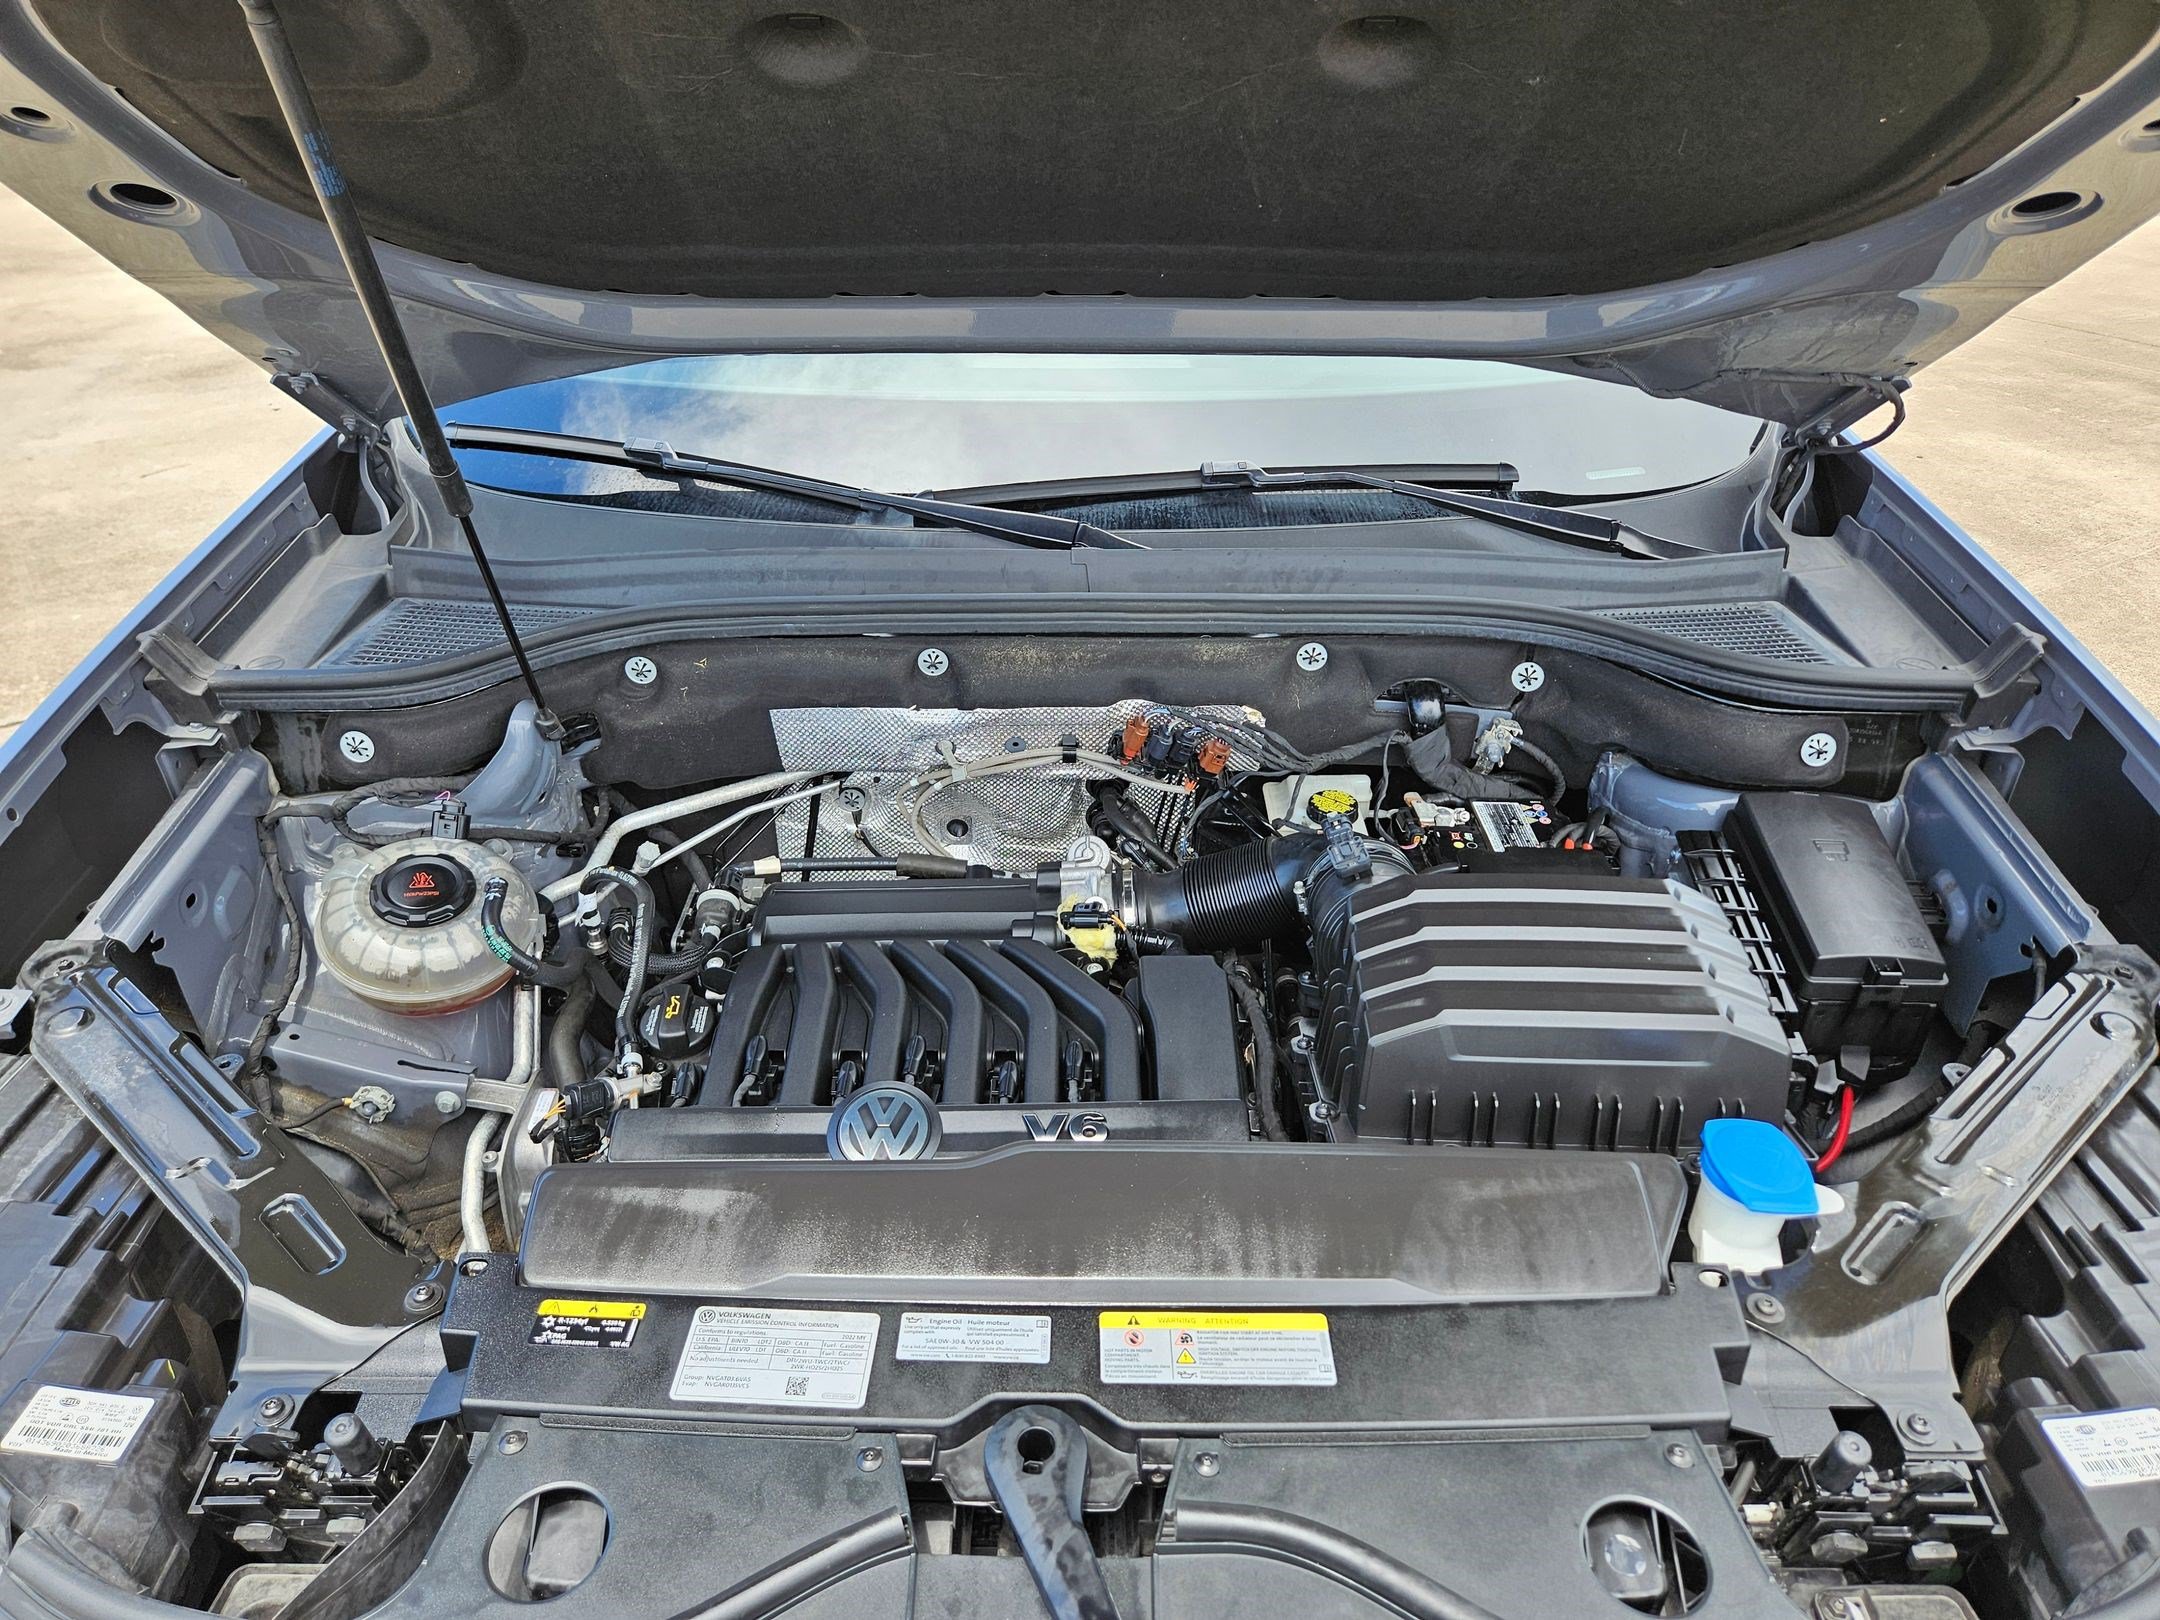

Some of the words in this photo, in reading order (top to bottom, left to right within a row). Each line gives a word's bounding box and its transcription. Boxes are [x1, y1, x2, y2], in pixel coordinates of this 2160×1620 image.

[1022, 1111, 1110, 1142] V6
[718, 1311, 771, 1320] VOLKSWAGEN
[798, 1321, 839, 1329] INFORMATION
[53, 1446, 72, 1454] Made
[82, 1449, 109, 1458] Mexico
